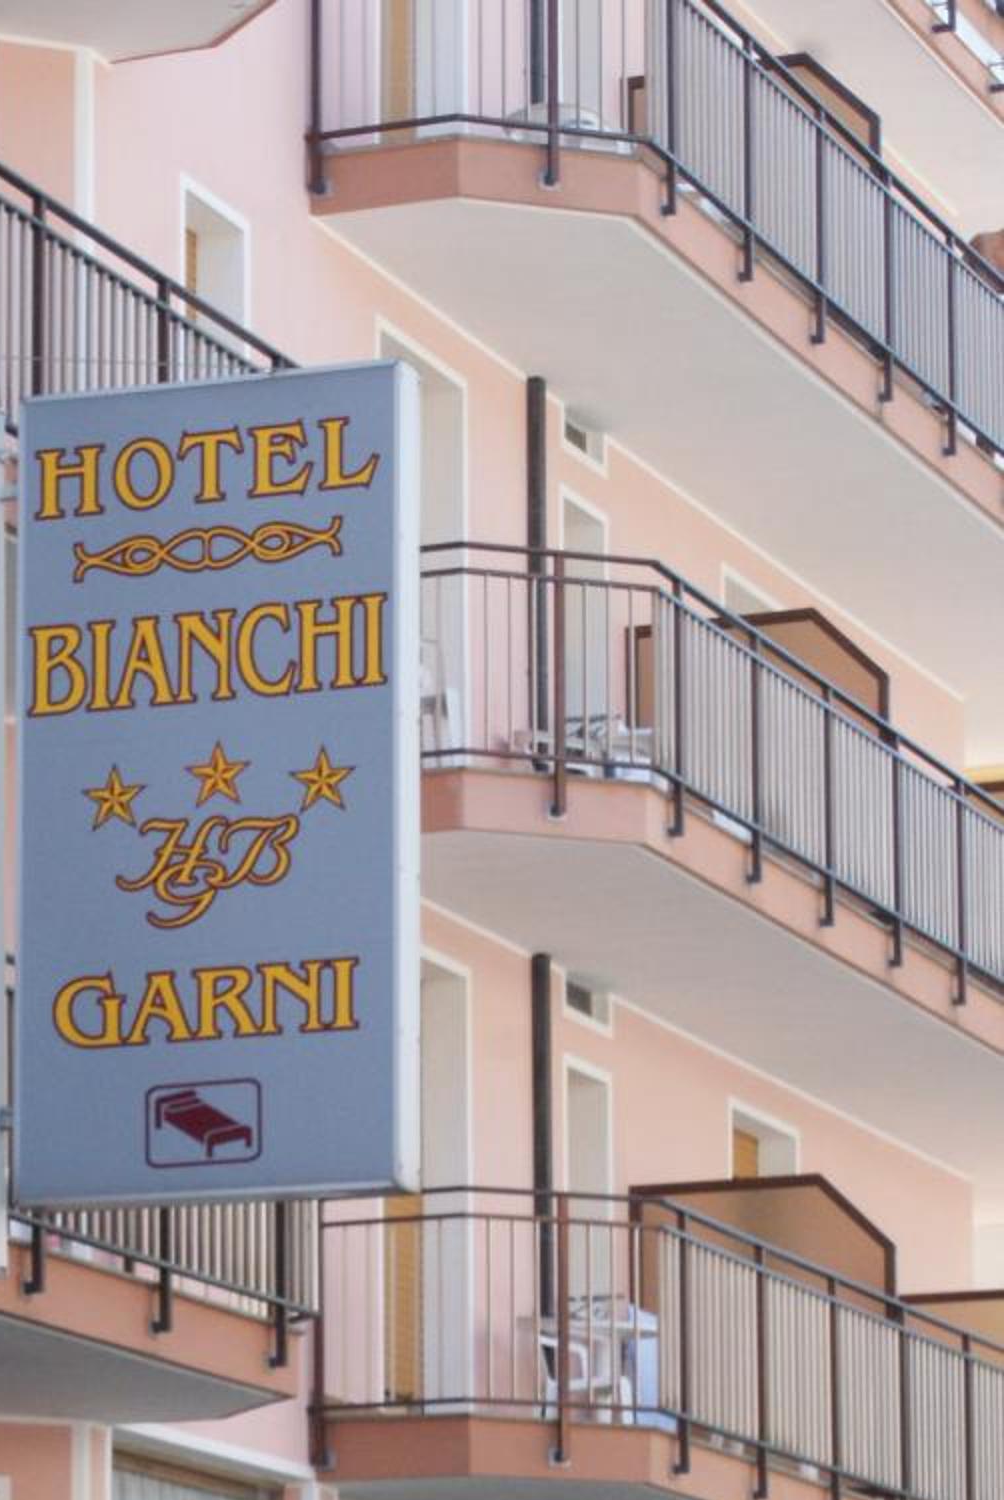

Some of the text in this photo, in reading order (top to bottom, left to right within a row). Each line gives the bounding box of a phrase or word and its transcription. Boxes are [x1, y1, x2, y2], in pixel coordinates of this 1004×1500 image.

[35, 416, 380, 520] HOTEL
[28, 592, 387, 718] BIANCHI
[52, 956, 360, 1050] GARNI
